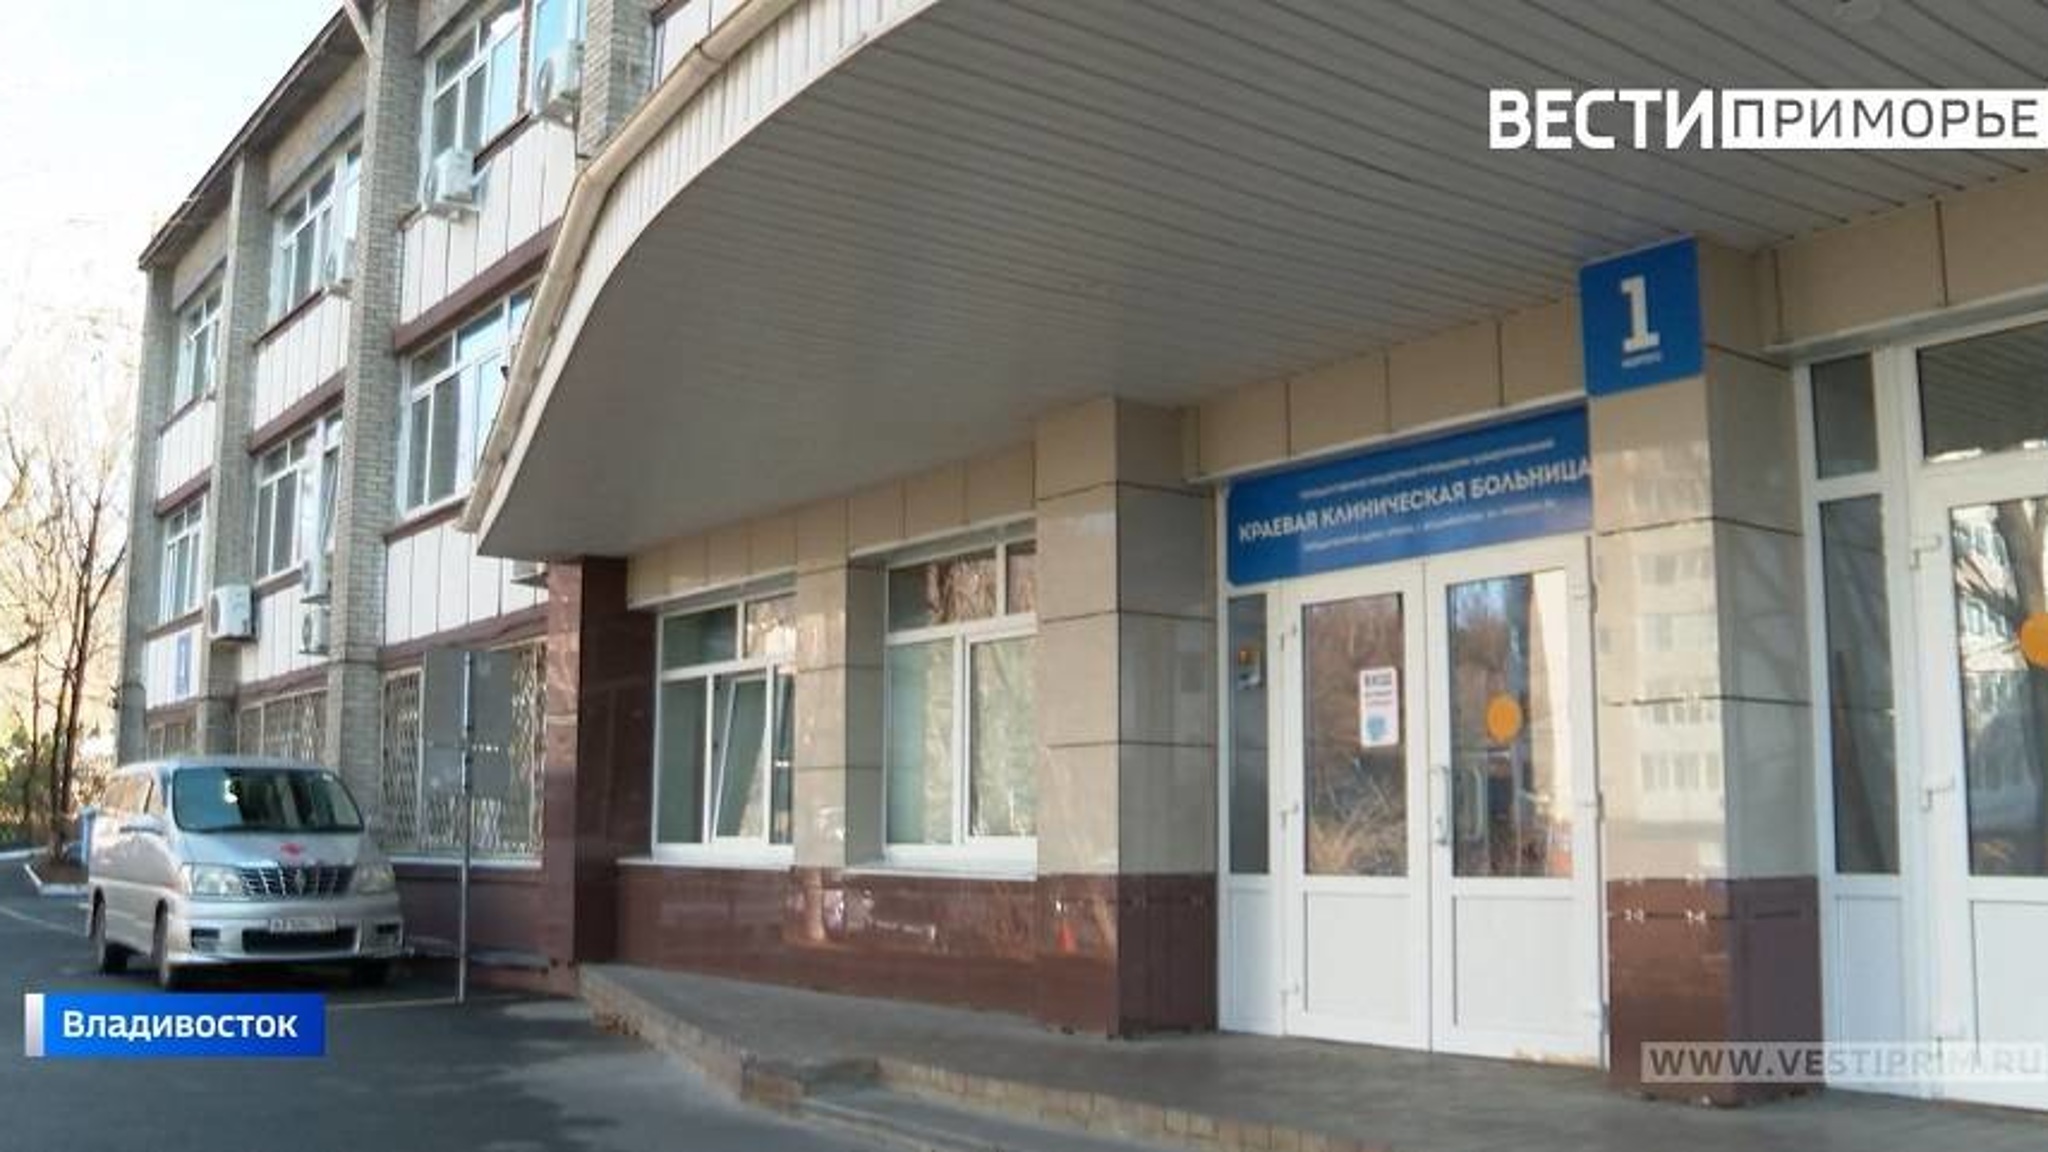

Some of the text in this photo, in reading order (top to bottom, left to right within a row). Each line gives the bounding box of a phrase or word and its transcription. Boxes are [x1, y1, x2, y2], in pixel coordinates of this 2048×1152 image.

[1621, 276, 1660, 353] 1
[1238, 509, 1319, 543] КРАЕВАЯ
[1321, 481, 1467, 528] КЛИНИЧЕСКАЯ
[1470, 457, 1593, 498] БОЛЬНИЦА
